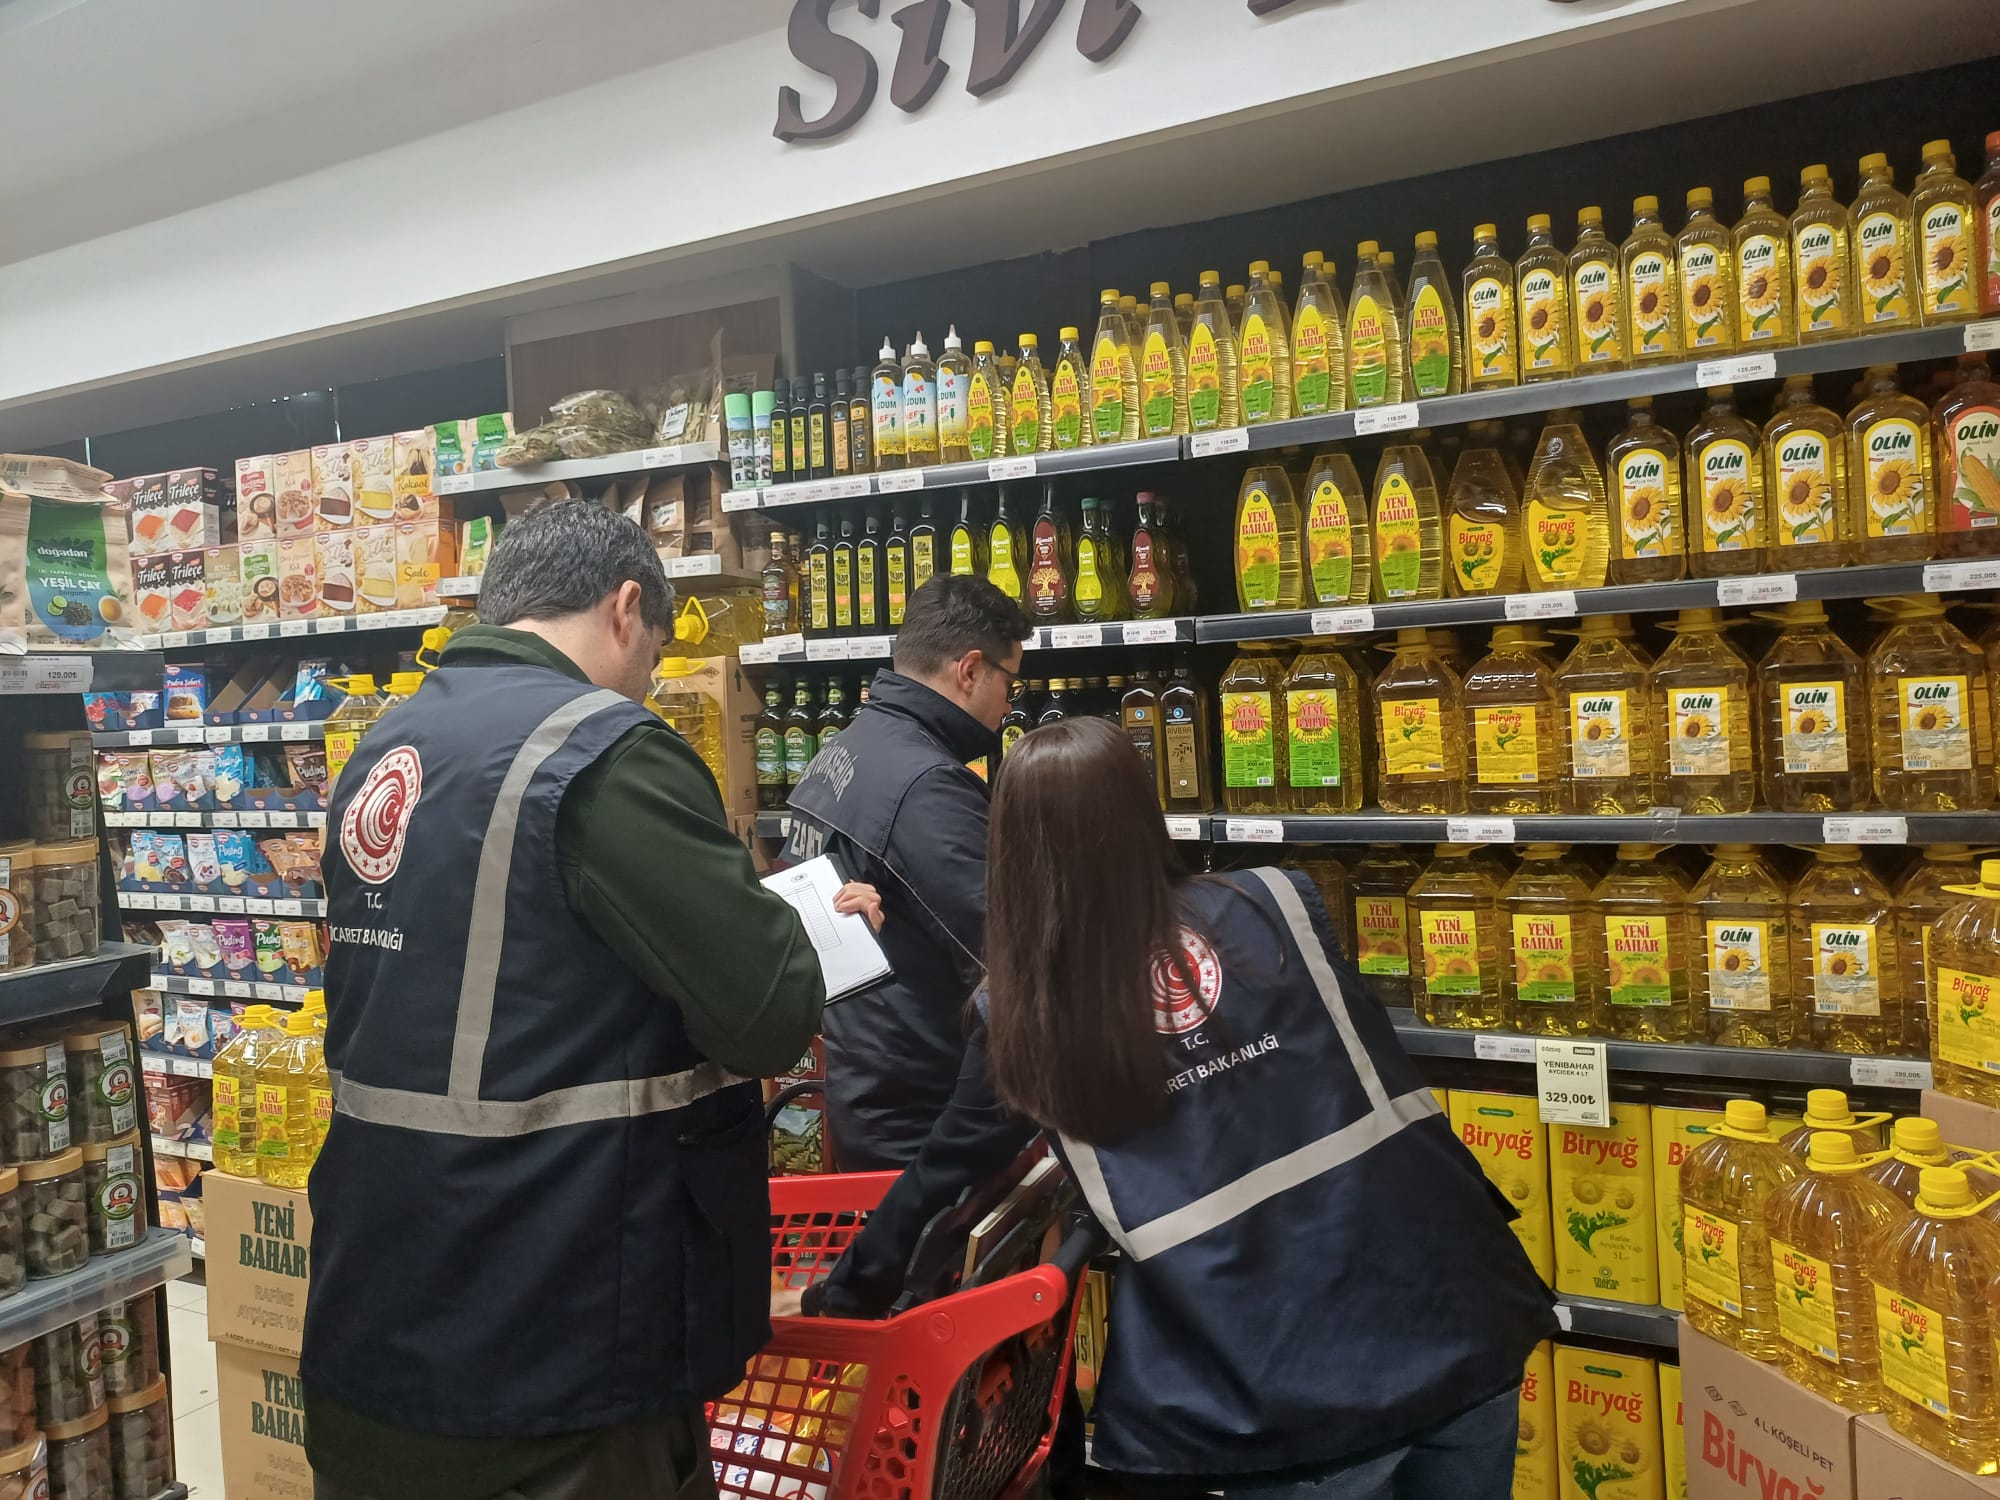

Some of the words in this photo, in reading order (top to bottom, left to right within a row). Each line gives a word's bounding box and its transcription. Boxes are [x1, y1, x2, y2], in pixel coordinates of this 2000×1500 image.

[1927, 212, 1958, 229] OLİN
[1863, 223, 1892, 239] OLİN
[1801, 234, 1830, 249] OLİN
[1687, 253, 1714, 268] OLİN
[1744, 245, 1771, 260] OLİN
[1635, 260, 1662, 275] OLİN
[1526, 278, 1551, 292] OLİN
[1580, 270, 1606, 285] OLİN
[1473, 287, 1498, 301] OLİN
[1418, 305, 1438, 319] YENİ
[1357, 315, 1376, 329] YENİ
[1414, 315, 1444, 329] BAHAR
[1353, 325, 1381, 339] BAHAR
[1297, 334, 1324, 347] BAHAR
[1243, 343, 1269, 356] BAHAR
[1958, 421, 1999, 440] OLİN
[1871, 431, 1912, 451] OLİN
[1782, 443, 1820, 462] OLİN
[1707, 453, 1743, 470] OLİN
[1625, 462, 1660, 480] OLİN
[134, 488, 164, 509] Trileçe
[169, 483, 200, 504] Trileçe
[1385, 494, 1408, 509] YENİ
[1247, 508, 1268, 523] YENİ
[1317, 501, 1339, 516] YENİ
[1379, 507, 1414, 522] BAHAR
[1242, 521, 1275, 535] BAHAR
[1311, 514, 1346, 529] BAHAR
[1537, 518, 1576, 535] Biryağ
[1458, 531, 1494, 545] Biryağ
[37, 546, 88, 558] doğadan
[138, 568, 167, 590] Trileçe
[172, 563, 203, 586] Trileçe
[39, 577, 77, 590] YEŞİL
[78, 579, 102, 592] ÇAY
[1794, 689, 1828, 705] OLİN
[1914, 683, 1951, 700] OLİN
[1583, 698, 1613, 713] OLİN
[1681, 694, 1713, 710] OLİN
[1394, 704, 1428, 719] Biryağ
[1368, 902, 1392, 917] YENİ
[1362, 915, 1400, 929] BAHAR
[1436, 916, 1461, 933] YENİ
[1528, 920, 1554, 937] YENİ
[1621, 921, 1651, 938] YENİ
[218, 936, 245, 949] Puding
[1429, 930, 1470, 945] BAHAR
[1720, 926, 1753, 943] OLİN
[1826, 929, 1860, 947] OLİN
[1521, 935, 1562, 951] BAHAR
[1614, 937, 1660, 954] BAHAR
[1952, 977, 1992, 1002] Biryağ
[1180, 1032, 1209, 1051] T.C.
[1196, 1032, 1280, 1079] BAKANLIĞI
[1543, 1060, 1595, 1071] YENIBAHAR
[1545, 1091, 1596, 1105] 329,00₺
[1462, 1123, 1534, 1161] Biryağ
[1562, 1130, 1639, 1169] Biryağ
[251, 1199, 295, 1241] YENİ
[1695, 1215, 1725, 1244] Biryağ
[239, 1233, 307, 1279] BAHAR
[1784, 1252, 1816, 1284] Biryağ
[1890, 1298, 1927, 1333] Biryağ
[1567, 1380, 1643, 1424] Biryağ
[1753, 1416, 1761, 1428] 4
[1762, 1422, 1769, 1433] L
[1771, 1425, 1810, 1458] KÖŞELİ
[1812, 1450, 1835, 1473] PET
